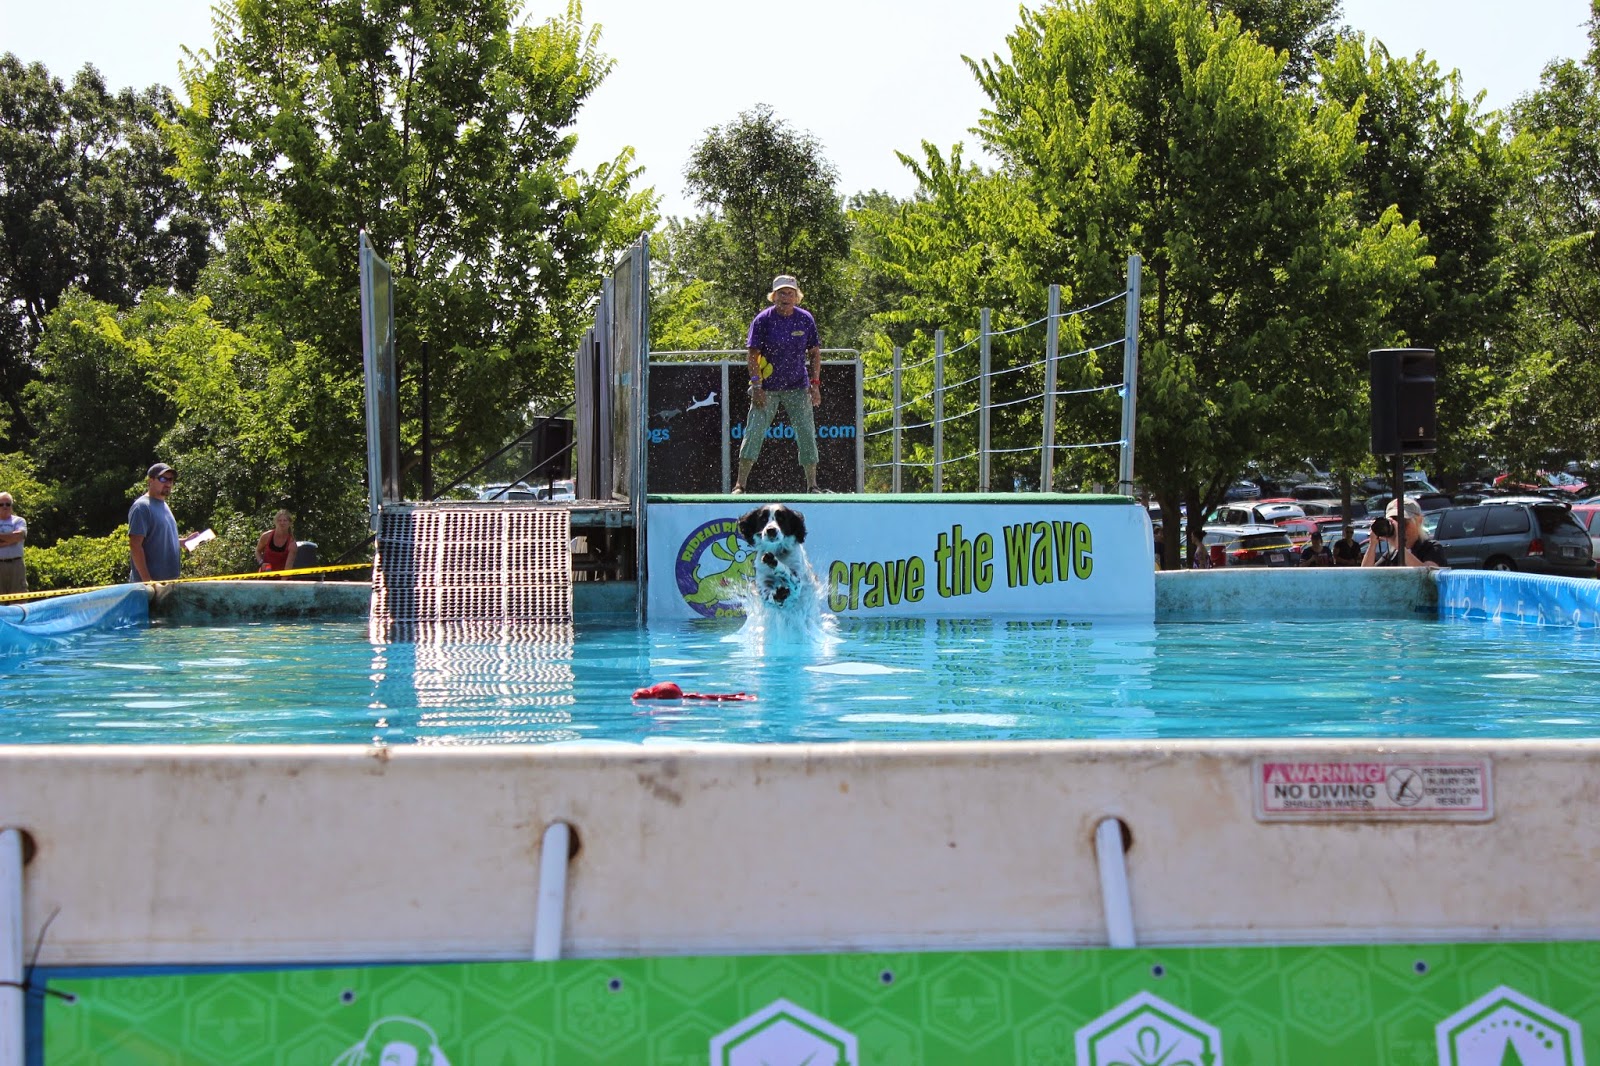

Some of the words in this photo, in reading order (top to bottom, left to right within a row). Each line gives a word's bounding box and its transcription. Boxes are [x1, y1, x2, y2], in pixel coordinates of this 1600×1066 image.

[681, 523, 721, 562] RIDEAU
[828, 556, 925, 612] crave
[934, 524, 993, 598] the
[1003, 520, 1093, 588] wave
[1287, 764, 1381, 781] WARNING
[1274, 784, 1303, 799] NO
[1308, 784, 1377, 799] DIVING
